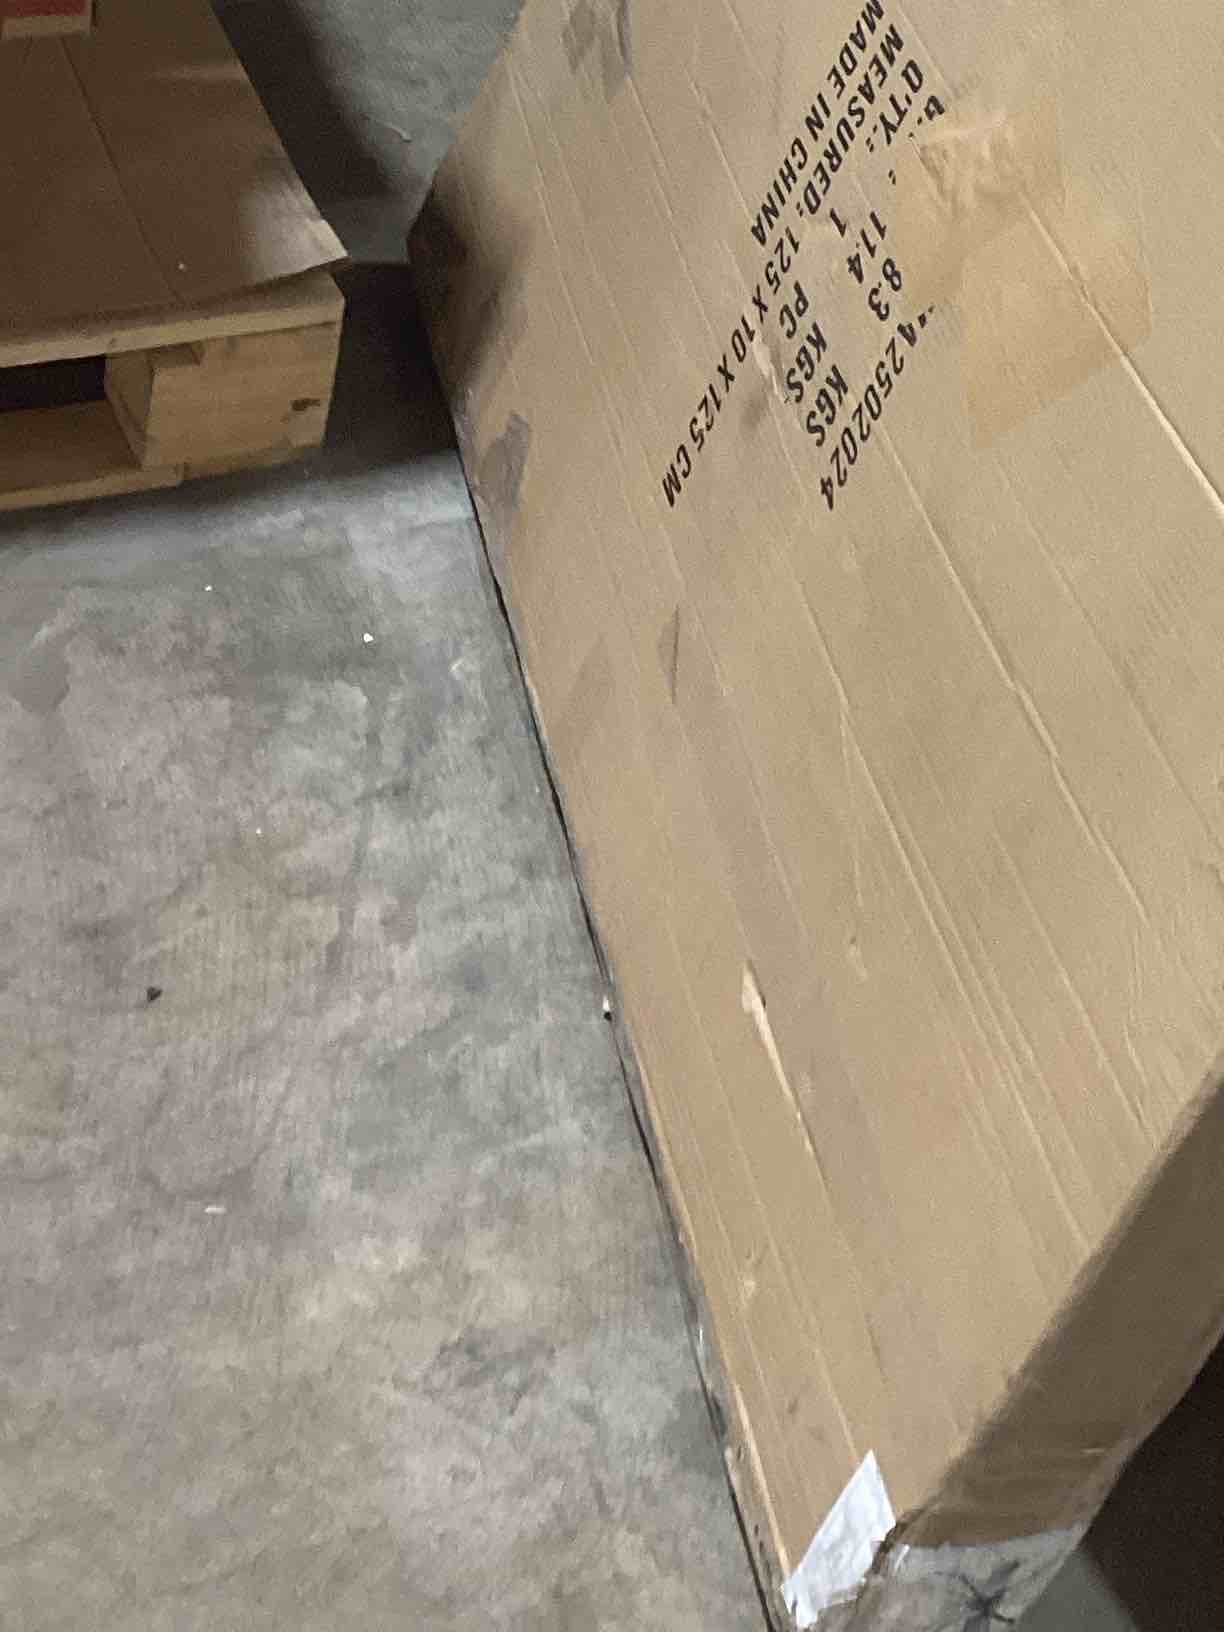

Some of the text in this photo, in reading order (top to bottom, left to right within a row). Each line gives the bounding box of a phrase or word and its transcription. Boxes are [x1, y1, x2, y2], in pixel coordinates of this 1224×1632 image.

[804, 92, 832, 142] IN
[750, 137, 809, 246] CHINA
[829, 207, 847, 238] 1
[662, 23, 905, 508] MEASURED: 125 X 10 X 125 CM
[779, 280, 809, 339] PC
[786, 211, 887, 403] 11.4 KGS
[806, 257, 902, 447] 8.3 KGS
